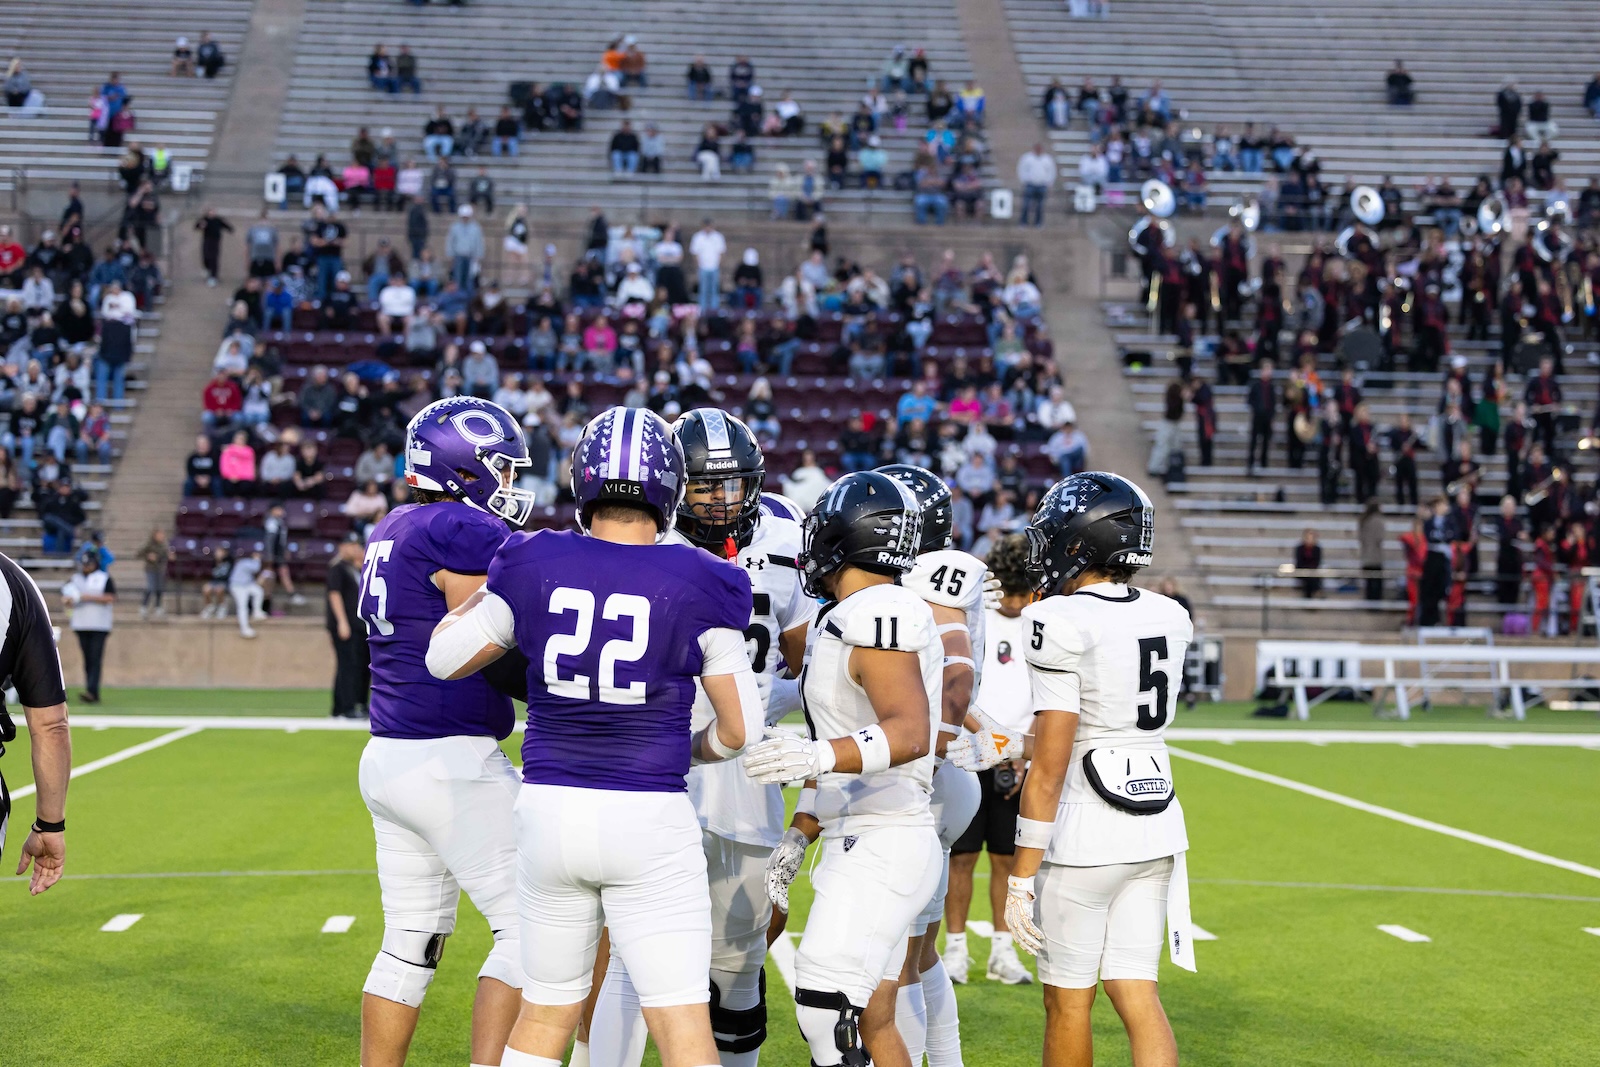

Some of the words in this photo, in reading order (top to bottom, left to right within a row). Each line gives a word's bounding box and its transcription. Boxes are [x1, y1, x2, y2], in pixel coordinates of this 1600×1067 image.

[706, 460, 739, 470] Riddell
[604, 483, 641, 495] VICIS
[826, 484, 851, 512] 11
[1060, 485, 1079, 513] 5
[356, 540, 395, 636] 75
[930, 565, 967, 597] 45
[543, 586, 651, 705] 22
[874, 616, 899, 649] 11
[1030, 620, 1045, 651] 5
[1136, 635, 1169, 731] 5
[1130, 781, 1166, 793] BATTLE
